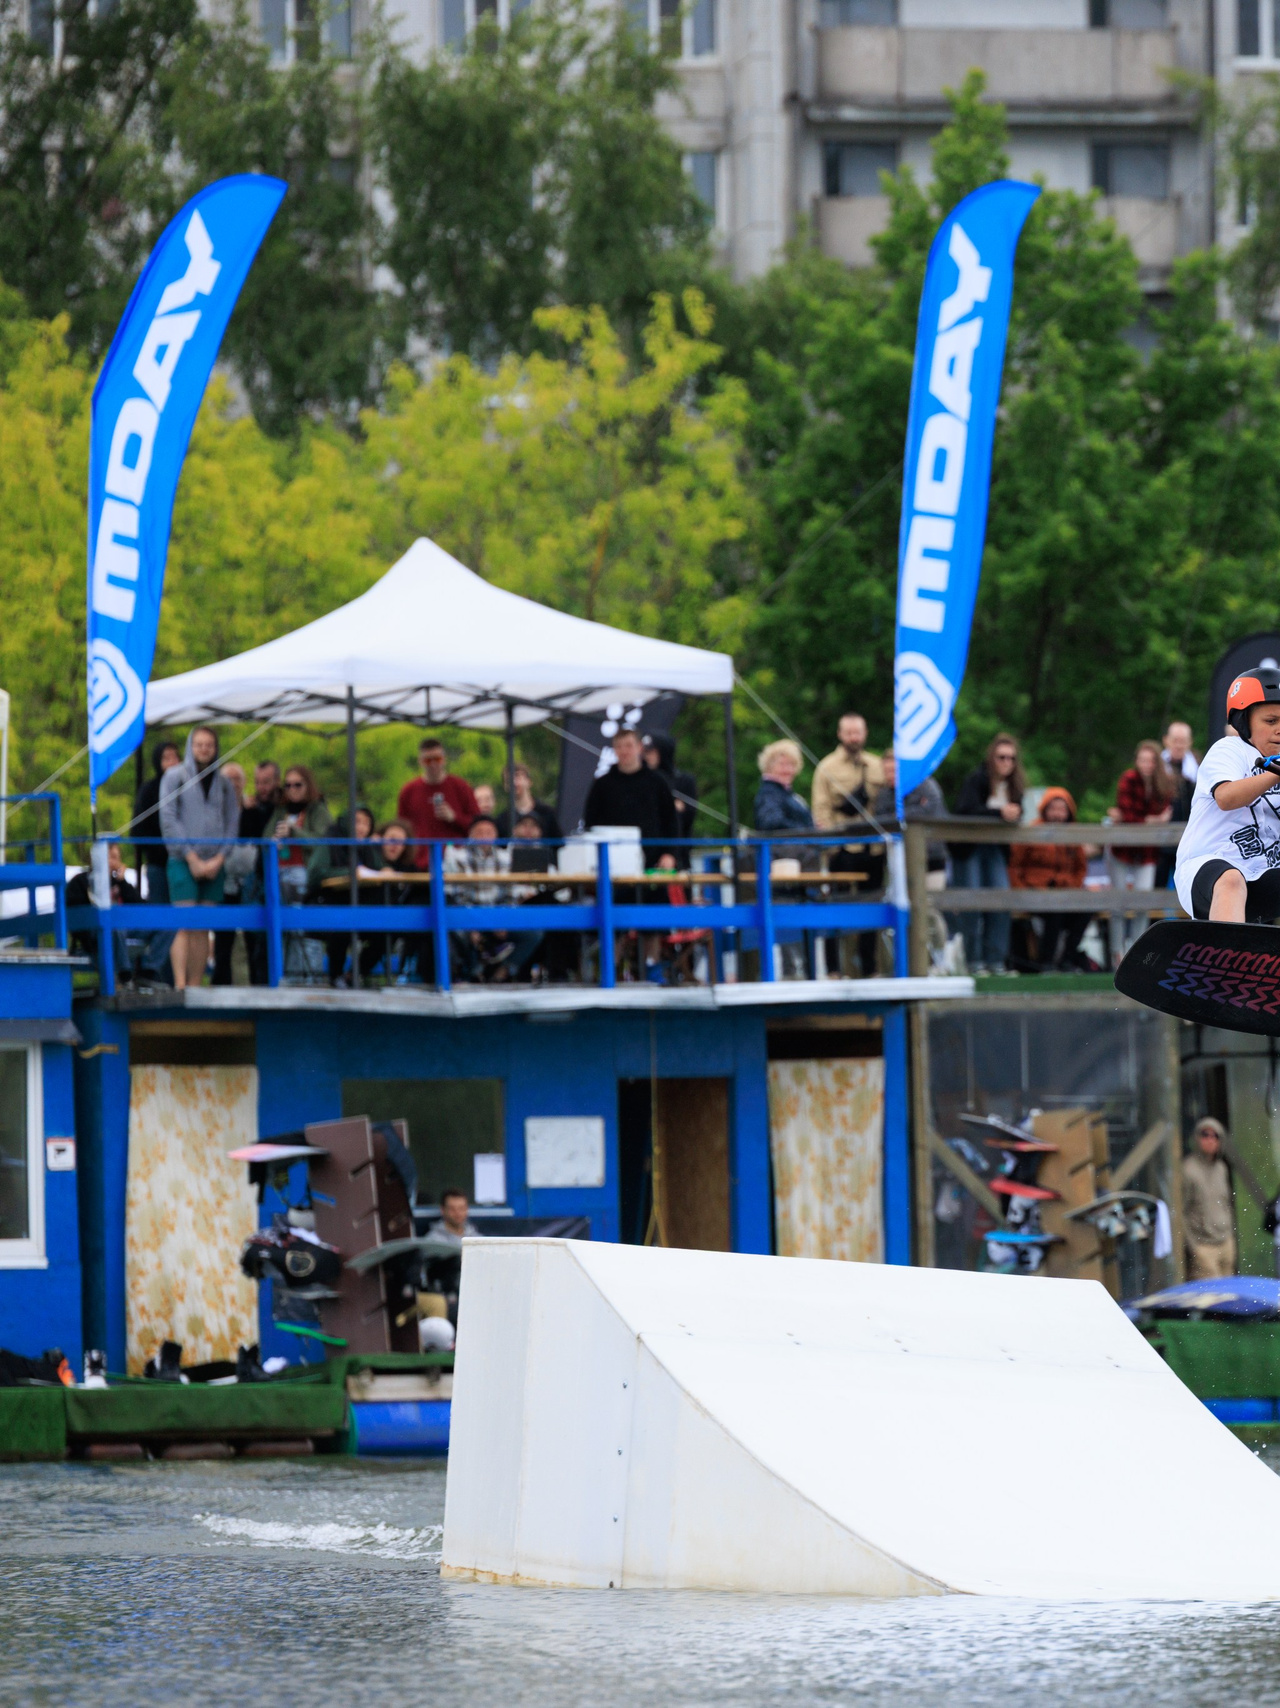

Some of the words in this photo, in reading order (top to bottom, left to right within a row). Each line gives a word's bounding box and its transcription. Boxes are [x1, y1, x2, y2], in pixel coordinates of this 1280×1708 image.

[1158, 943, 1202, 991] MIR
[1176, 946, 1221, 996] MIR
[1194, 949, 1240, 1000] MIR
[1211, 951, 1259, 1004] MIR
[1228, 953, 1276, 1008] MIR
